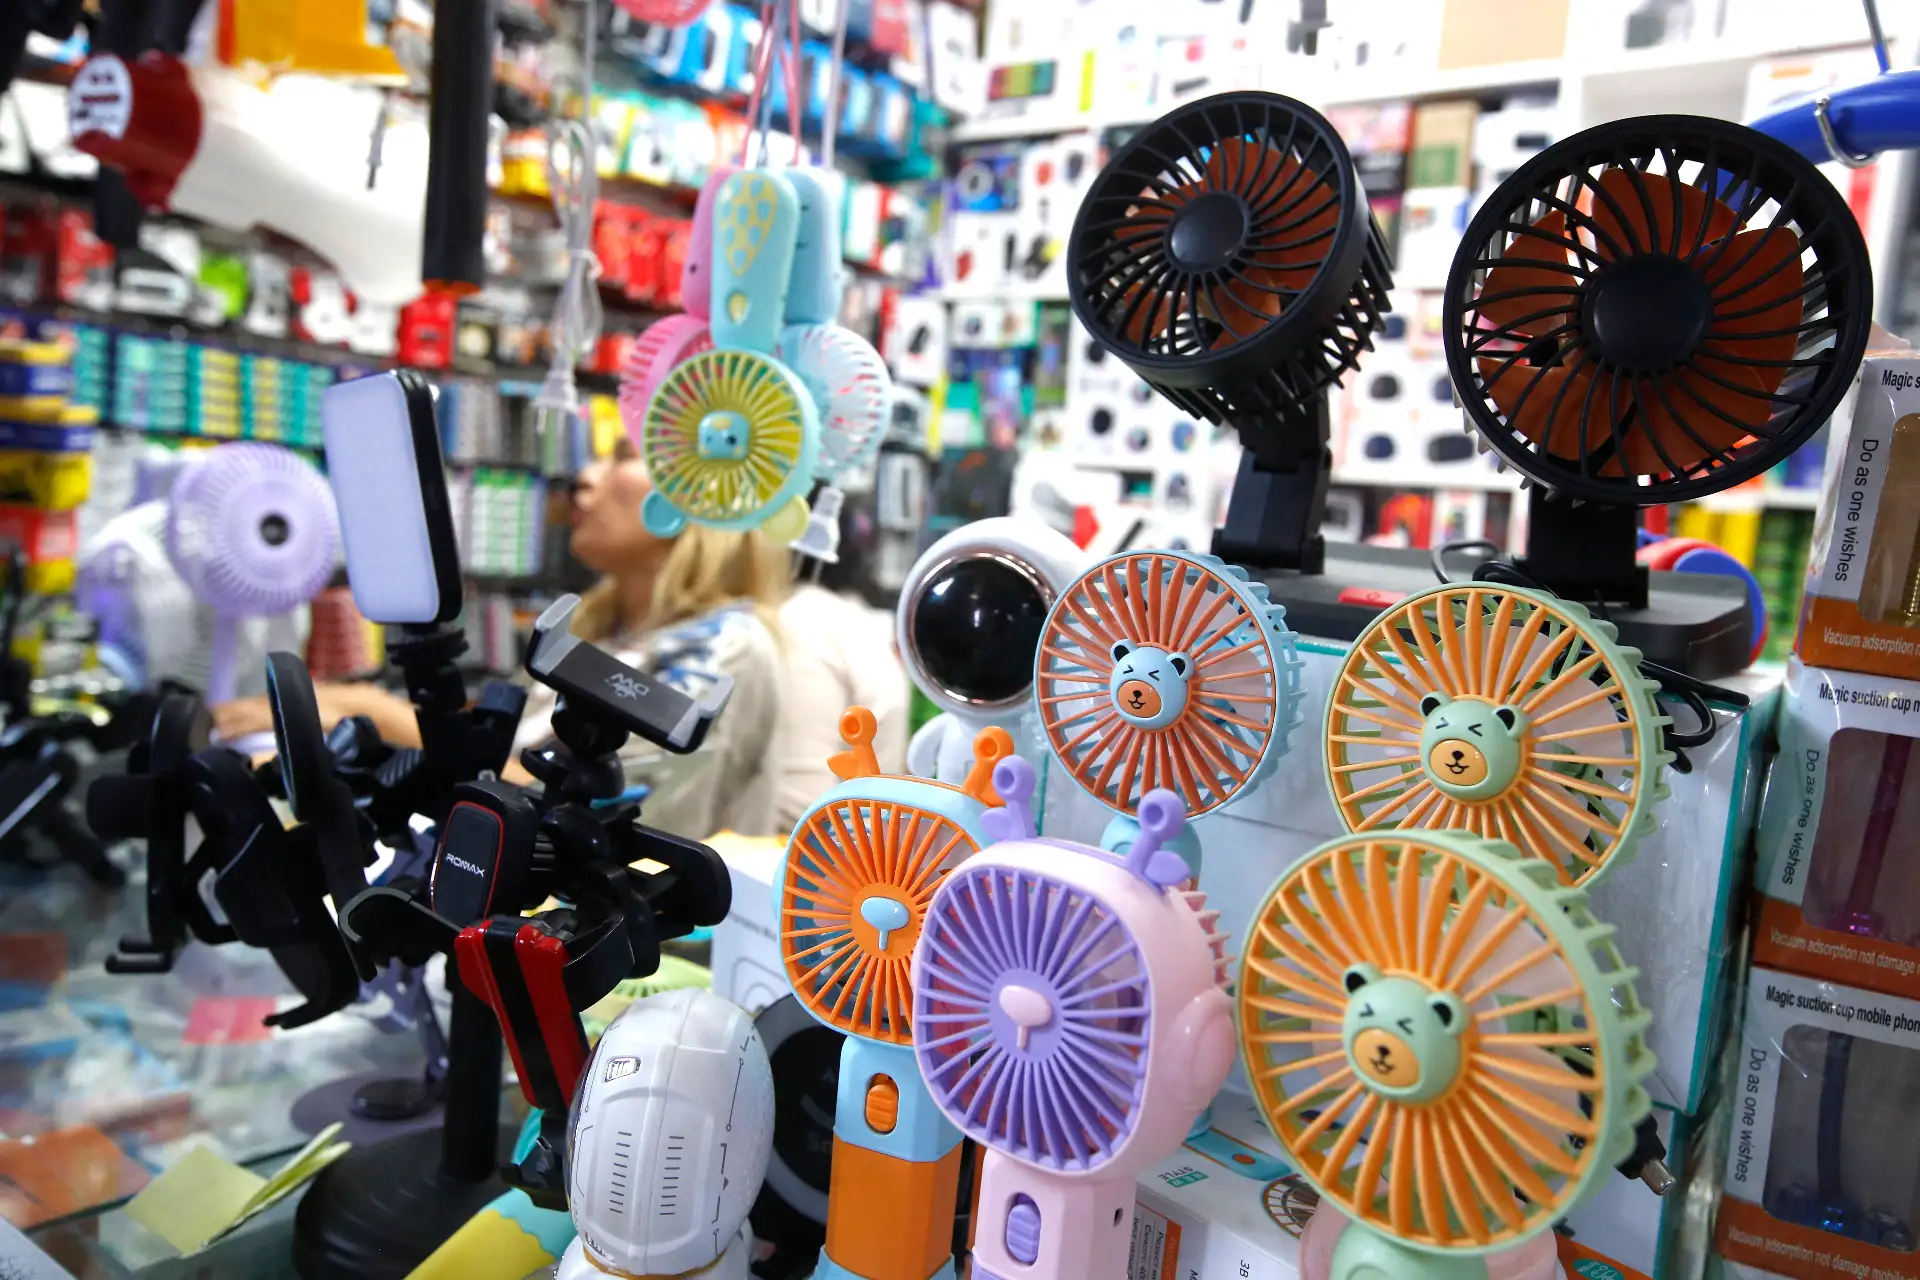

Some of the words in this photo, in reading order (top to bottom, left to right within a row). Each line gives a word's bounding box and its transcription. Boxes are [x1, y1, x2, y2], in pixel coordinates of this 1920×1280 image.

[1882, 369, 1913, 391] Magic
[1860, 439, 1879, 462] Do
[1855, 470, 1870, 486] as
[1848, 493, 1864, 521] one
[1835, 526, 1860, 582] wishes
[1824, 626, 1860, 647] Vacuum
[1862, 633, 1914, 656] adsorption
[1820, 683, 1849, 705] Magic
[1851, 690, 1888, 708] suction
[1891, 695, 1911, 714] cup
[1806, 749, 1819, 772] Do
[1806, 776, 1816, 794] as
[1798, 802, 1812, 828] one
[446, 853, 485, 877] ROMAX
[1782, 832, 1804, 885] wishes
[1770, 926, 1806, 949] Vacuum
[1807, 938, 1857, 961] adsorption
[1859, 950, 1875, 964] not
[1877, 954, 1915, 976] damage
[1766, 985, 1794, 1009] Magic
[1797, 994, 1833, 1014] suction
[1836, 1004, 1854, 1021] cup
[1857, 1007, 1891, 1026] mobile
[1750, 1048, 1767, 1071] Do
[1746, 1074, 1760, 1094] as
[1743, 1097, 1757, 1127] one
[1735, 1130, 1755, 1183] wishes
[1728, 1224, 1763, 1247] Vacuum
[1764, 1238, 1813, 1261] adsorption
[1815, 1252, 1831, 1267] not
[1832, 1254, 1870, 1280] damage
